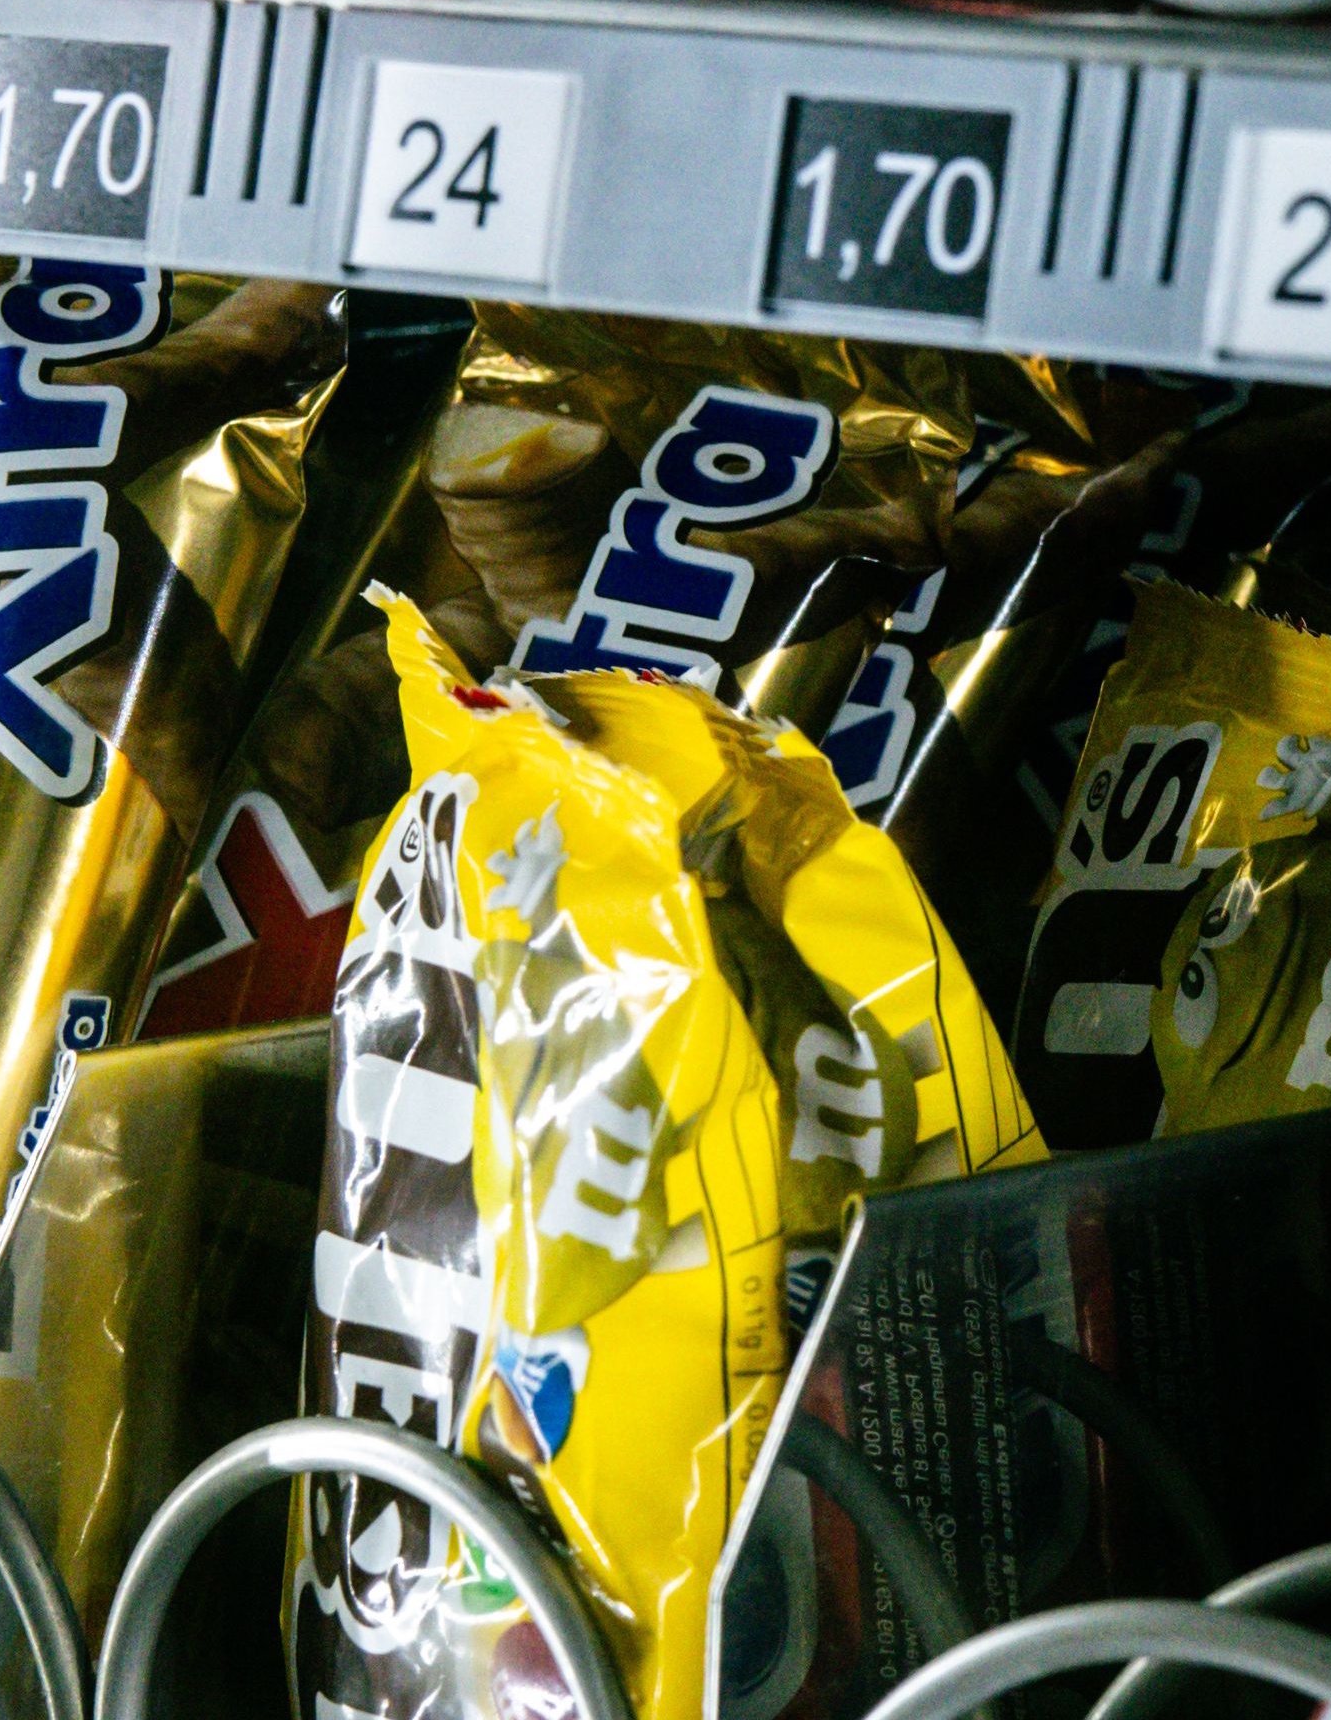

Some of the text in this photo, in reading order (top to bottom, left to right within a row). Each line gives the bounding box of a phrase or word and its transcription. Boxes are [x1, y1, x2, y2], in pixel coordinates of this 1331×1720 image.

[388, 118, 501, 230] 24
[795, 145, 997, 278] 1,70
[507, 384, 841, 688] tra
